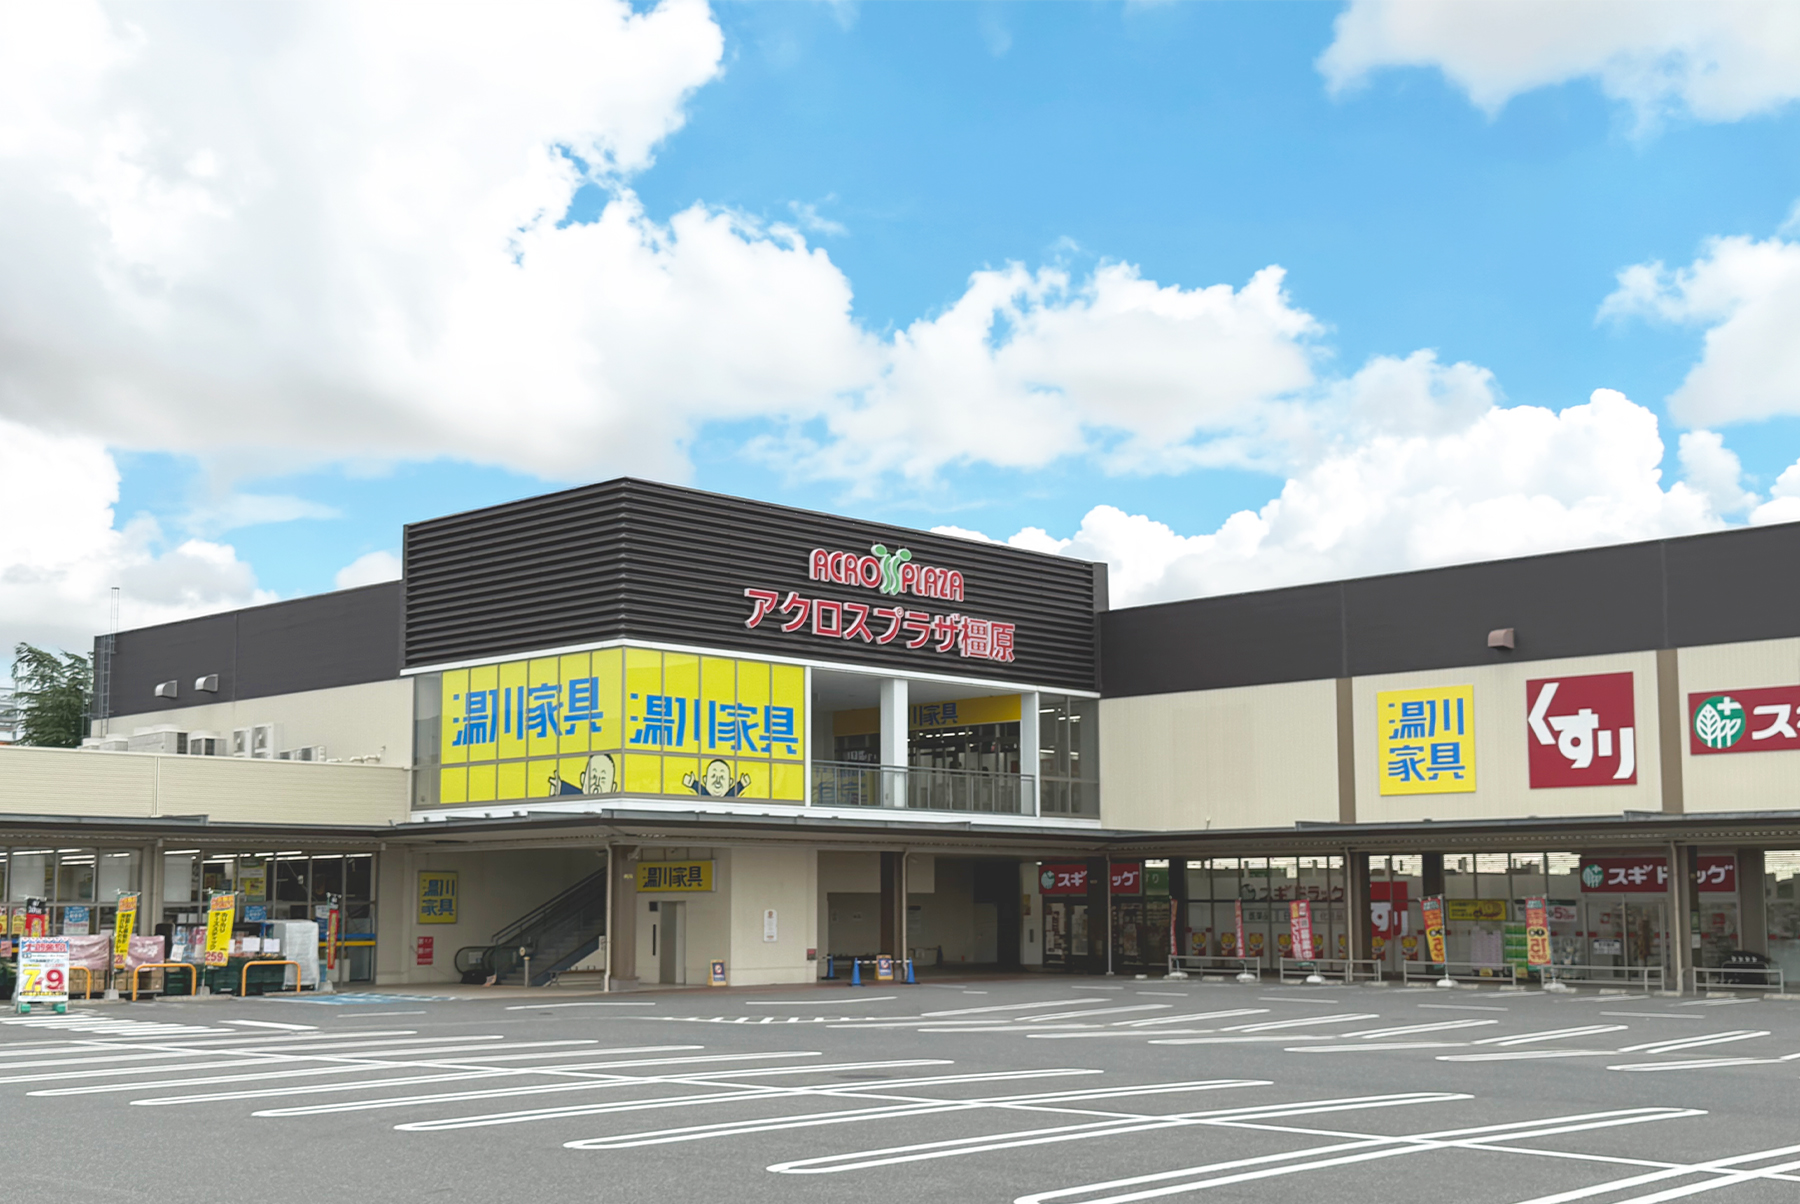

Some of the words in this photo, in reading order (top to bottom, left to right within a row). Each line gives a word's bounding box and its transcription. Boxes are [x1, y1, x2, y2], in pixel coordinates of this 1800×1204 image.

[900, 564, 965, 602] PLAZA
[743, 587, 1017, 663] アクロスプラザ橿原
[451, 676, 603, 746] 湯川家具
[628, 691, 800, 757] 湯川家具
[1388, 696, 1466, 739] 湯川
[1528, 681, 1635, 780] くすり
[1751, 703, 1800, 741] ス
[1388, 741, 1466, 782] 家具
[422, 878, 456, 897] 湯川
[642, 865, 704, 889] 湯川家具
[421, 898, 455, 916] 家具
